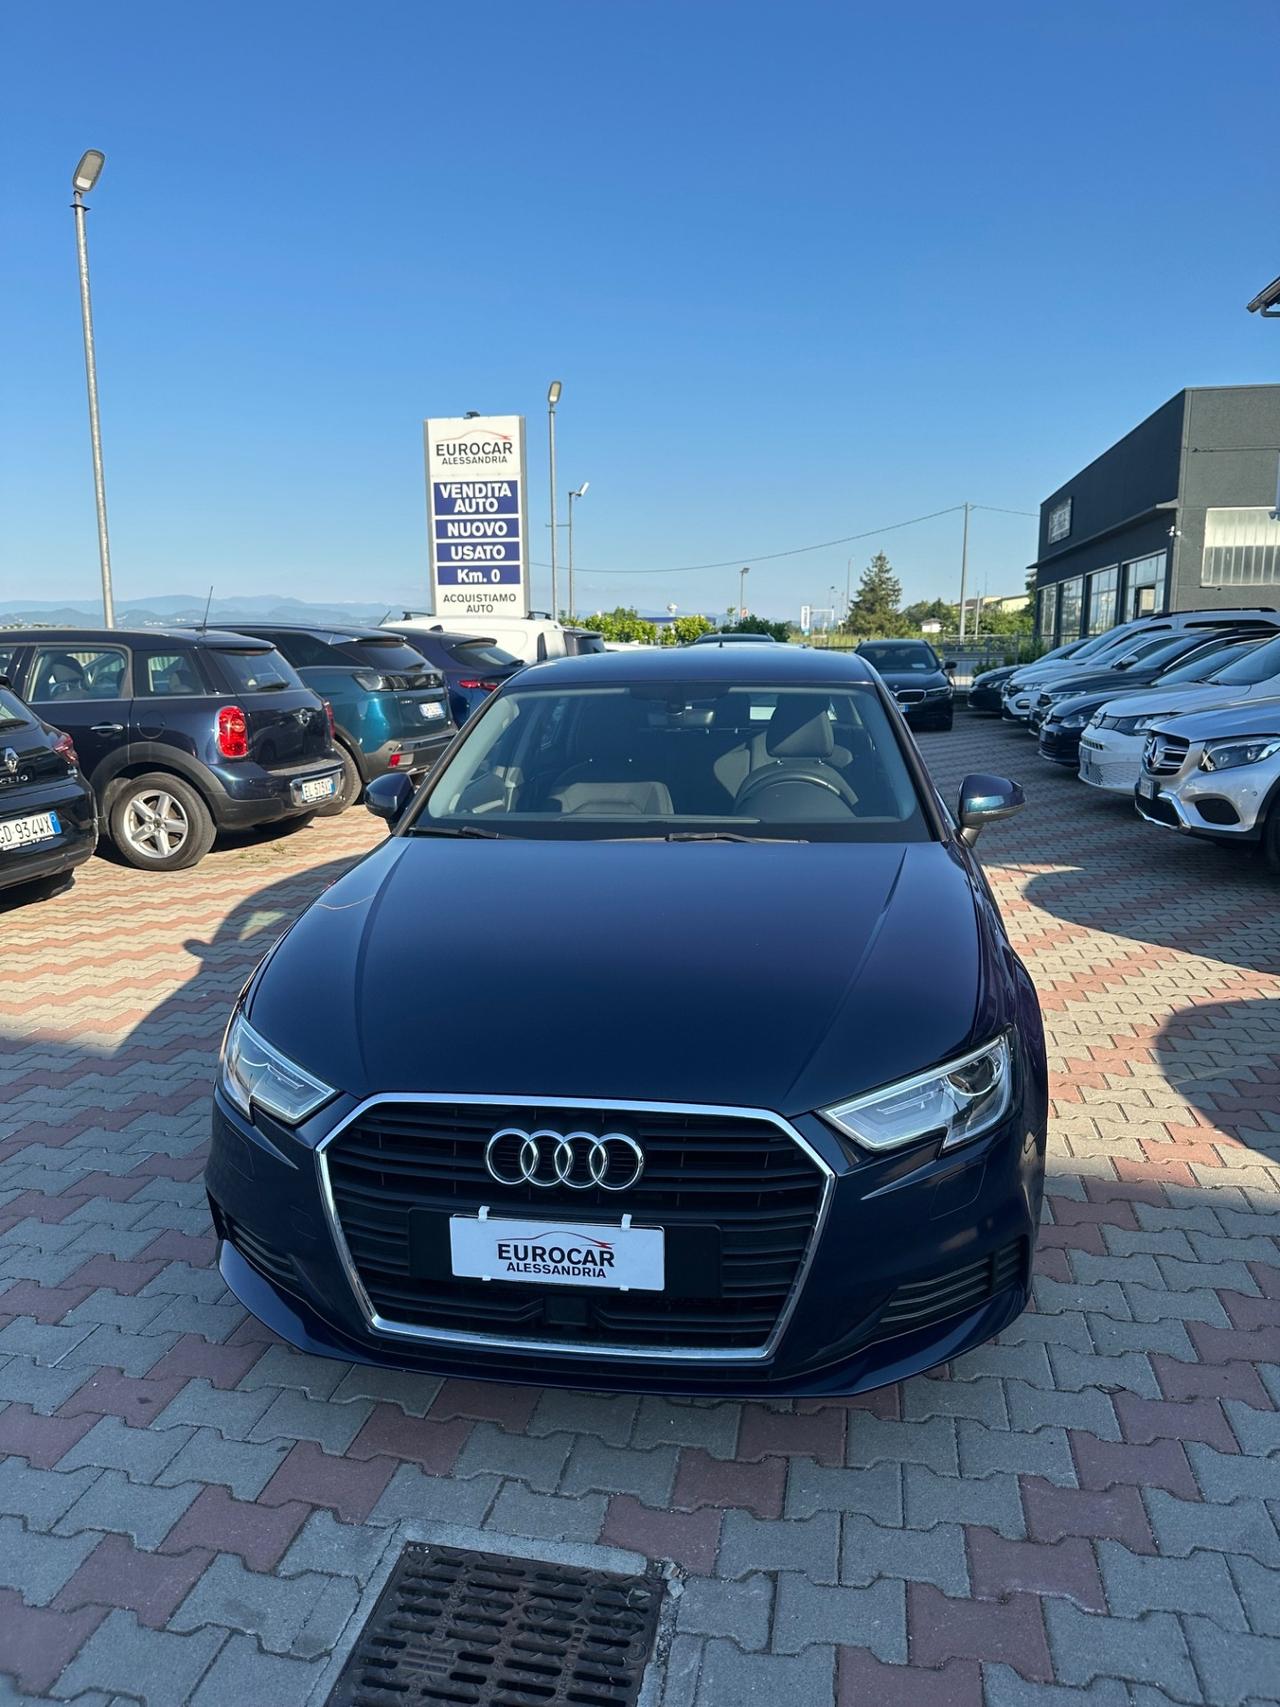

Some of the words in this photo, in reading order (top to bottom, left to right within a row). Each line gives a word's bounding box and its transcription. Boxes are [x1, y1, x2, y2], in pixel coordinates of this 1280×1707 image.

[436, 442, 513, 456] EUROCAR
[442, 456, 508, 465] ALESSANDRIA
[439, 482, 512, 499] VENDITA
[453, 498, 499, 513] AUTO
[447, 521, 508, 537] NUOVO
[450, 544, 506, 560] USATO
[457, 569, 488, 583] Km.
[491, 569, 501, 583] 0
[443, 593, 517, 604] ACQUISTIAMO
[466, 604, 494, 613] AUTO
[15, 816, 52, 840] 934WX
[497, 1243, 615, 1268] EUROCAR
[506, 1262, 607, 1278] ALESSANDRIA
